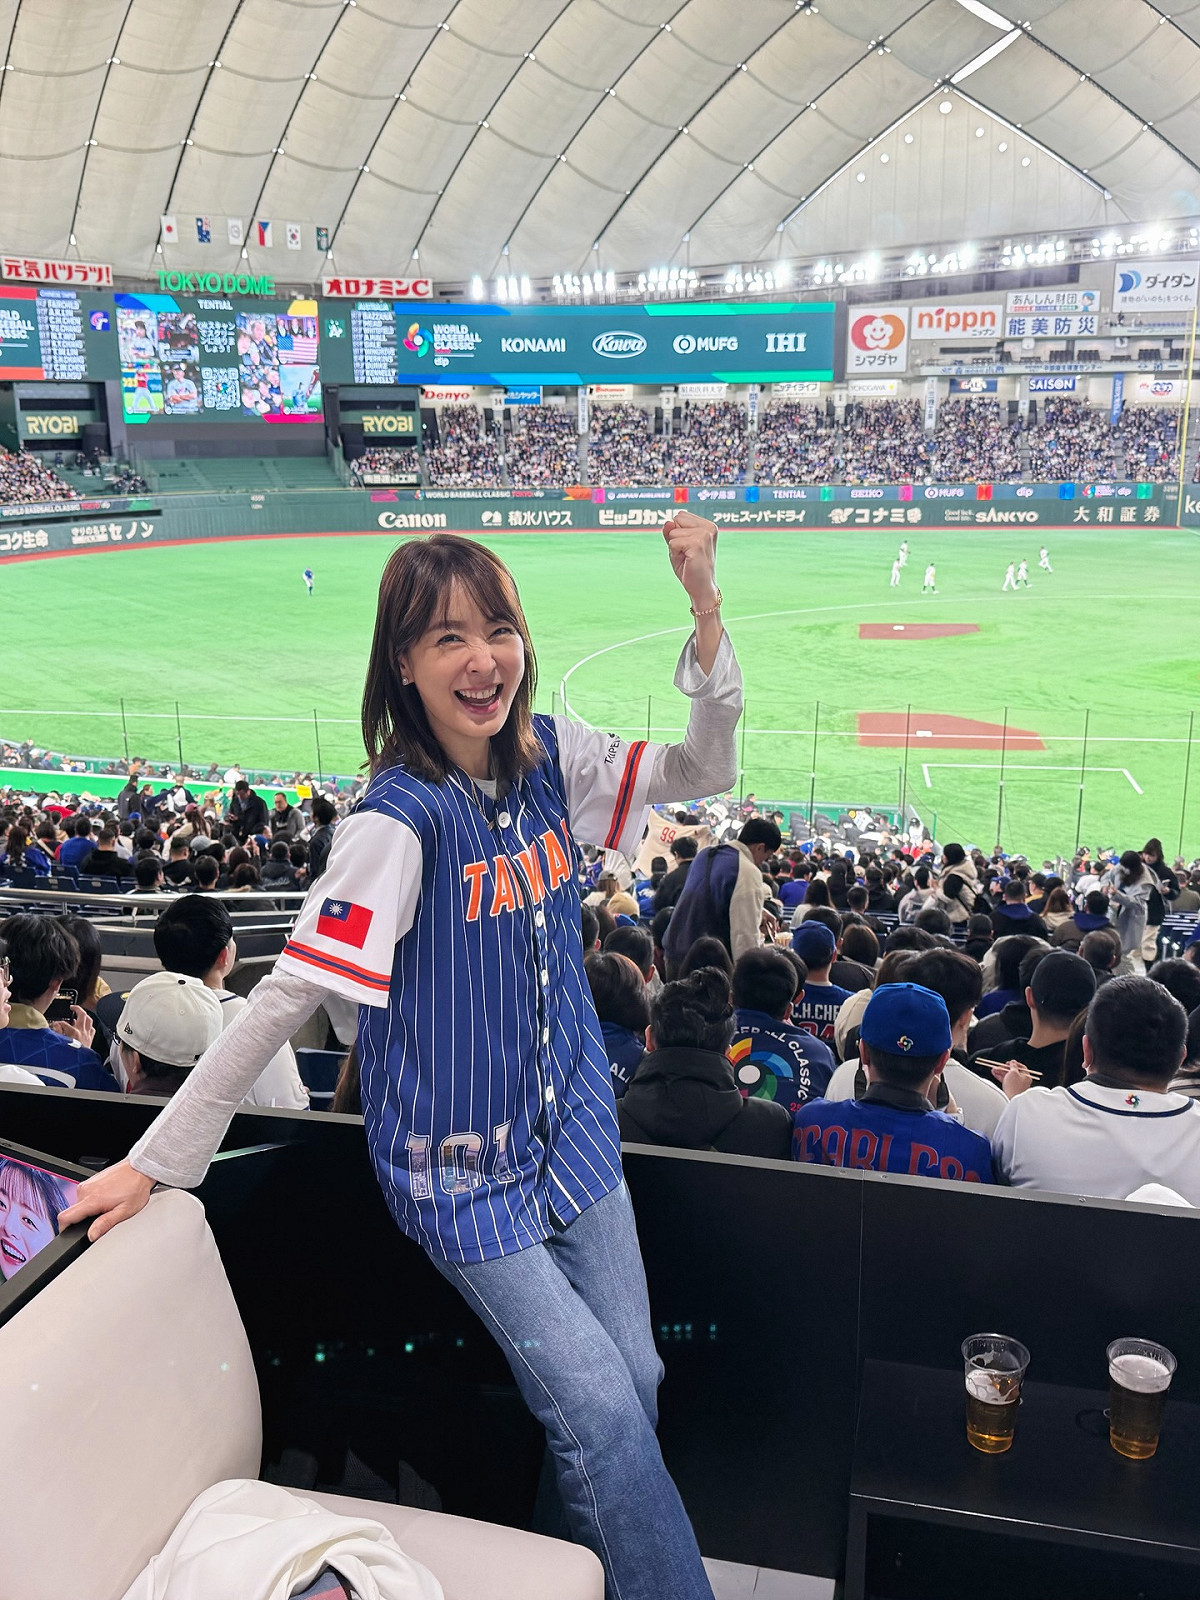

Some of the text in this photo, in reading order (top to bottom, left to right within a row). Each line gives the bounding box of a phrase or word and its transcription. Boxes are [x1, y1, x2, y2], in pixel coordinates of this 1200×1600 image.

[4, 258, 111, 284] 元気ハツラツ!
[156, 270, 276, 295] TOKYO DOME
[326, 279, 429, 296] オロナミンC
[1145, 273, 1196, 288] ダイダン
[197, 299, 233, 310] TENTIAL
[1013, 293, 1077, 305] あんしん財団
[917, 308, 996, 332] nippn
[1008, 316, 1095, 336] 能美防災
[433, 324, 468, 334] WORLD
[434, 332, 482, 342] BASEBALL
[599, 335, 645, 353] Kowa
[698, 336, 738, 351] MUFG
[765, 332, 807, 353] IHI
[501, 338, 566, 353] KONAMI
[434, 357, 450, 368] dip
[855, 353, 898, 366] シマダヤ
[850, 384, 887, 392] YOKOGAWA
[1029, 378, 1073, 390] SAISON
[424, 390, 470, 401] Denyo
[26, 416, 79, 435] RYOBI
[362, 416, 414, 433] RYOBI
[426, 490, 449, 499] WORLD
[451, 490, 482, 498] BASEBALL
[483, 490, 511, 498] CLASSIC
[773, 490, 807, 499] TENTIAL
[850, 489, 884, 498] SEIKO
[938, 489, 965, 498] MUFG
[1015, 486, 1034, 498] dip
[2, 508, 24, 517] WORLD
[25, 506, 54, 515] BASEBALL
[508, 510, 573, 526] 積水ハウス
[713, 510, 807, 523] アサヒスーパードライ
[975, 507, 1039, 523] SANKYO
[1073, 506, 1161, 523] 大和証券
[377, 511, 447, 528] Canon
[0, 529, 49, 551] コク生命
[791, 1002, 842, 1021] C.H.CHE
[788, 1040, 811, 1101] CLASSIC
[405, 1118, 516, 1201] 101
